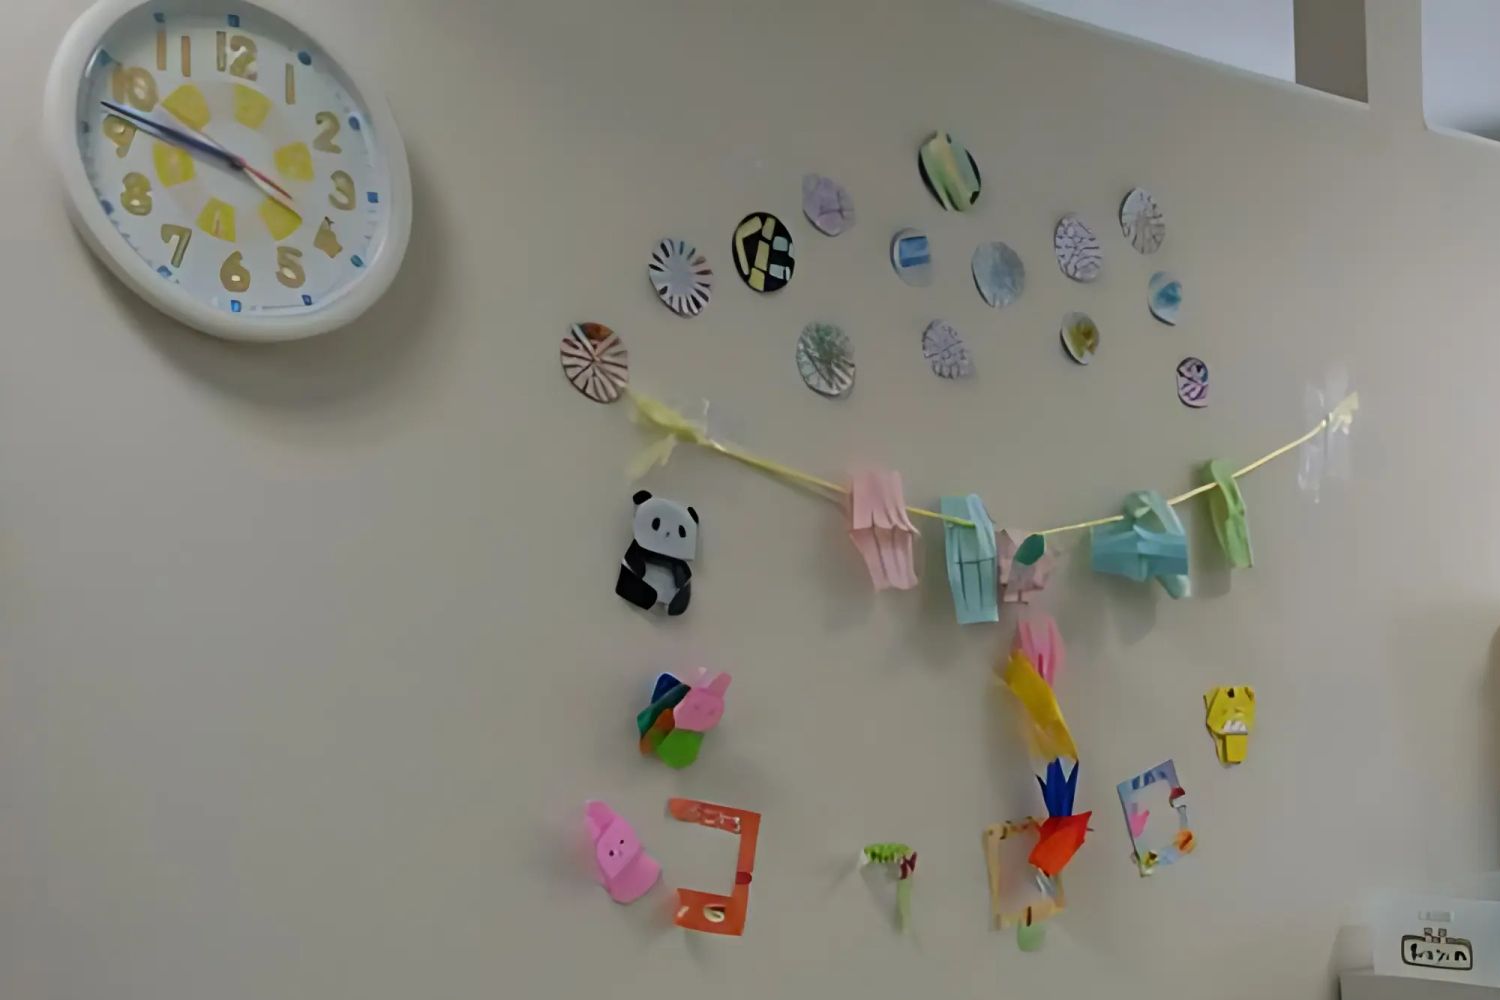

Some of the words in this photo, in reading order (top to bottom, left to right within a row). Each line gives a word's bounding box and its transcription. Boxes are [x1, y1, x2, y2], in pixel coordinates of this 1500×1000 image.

[156, 30, 191, 77] 11
[216, 31, 258, 81] 12
[111, 63, 159, 112] 10
[285, 63, 295, 105] 1
[103, 114, 137, 158] 9
[313, 111, 342, 154] 2
[120, 172, 153, 216] 8
[328, 170, 356, 210] 3
[161, 224, 192, 268] 7
[275, 246, 306, 289] 5
[220, 251, 251, 293] 6
